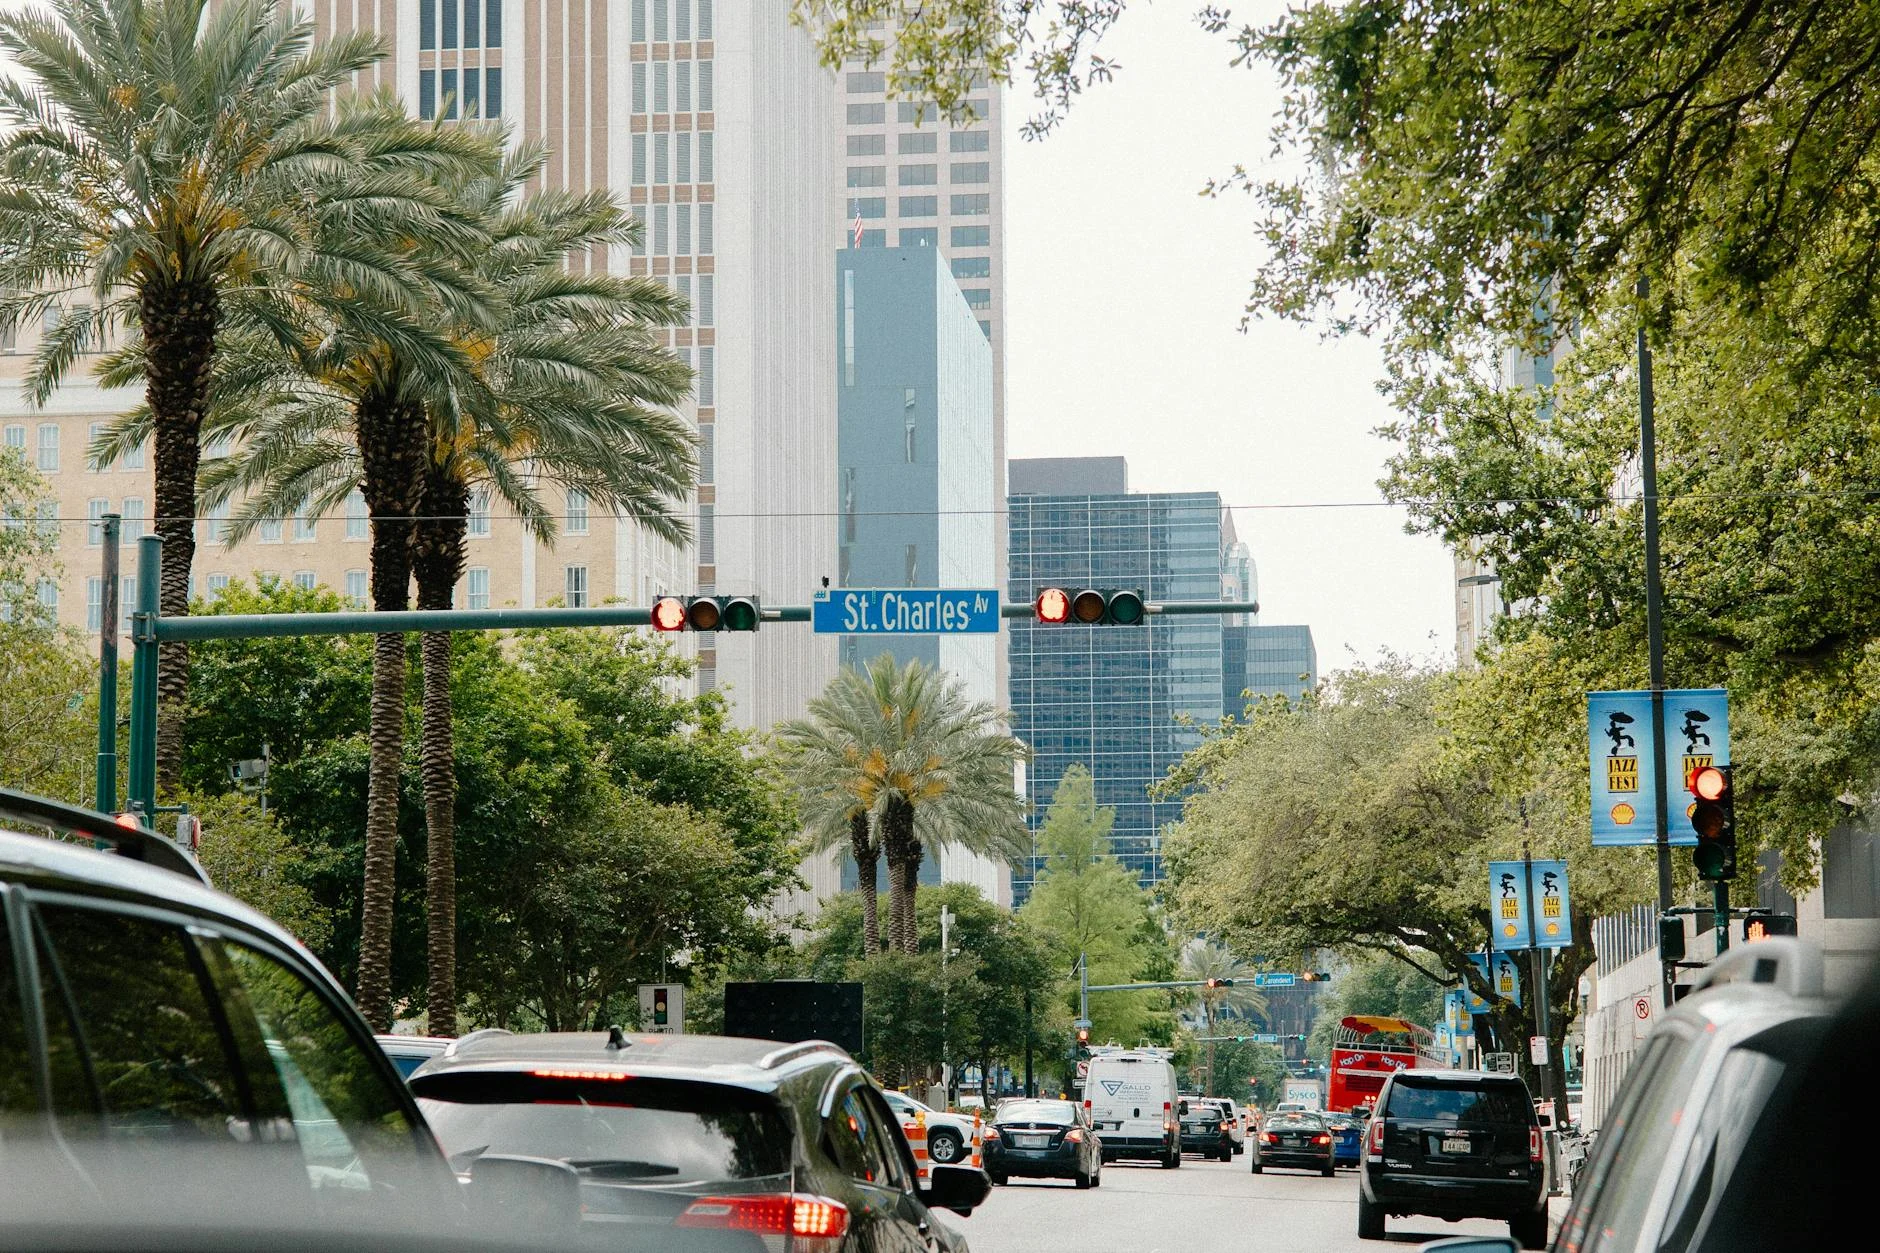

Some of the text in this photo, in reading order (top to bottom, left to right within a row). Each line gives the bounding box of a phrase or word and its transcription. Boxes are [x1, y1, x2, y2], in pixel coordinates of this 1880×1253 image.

[844, 592, 989, 630] St. Charles Av
[1609, 759, 1638, 773] JAZZ
[1609, 776, 1638, 790] FEST
[1502, 899, 1517, 907] JAZZ
[1544, 898, 1559, 906] JAZZ
[1502, 908, 1518, 917] FEST
[1544, 907, 1560, 916] FEST
[1339, 1053, 1365, 1067] Hop On
[1381, 1055, 1395, 1066] Hop
[1289, 1089, 1316, 1101] Sysco
